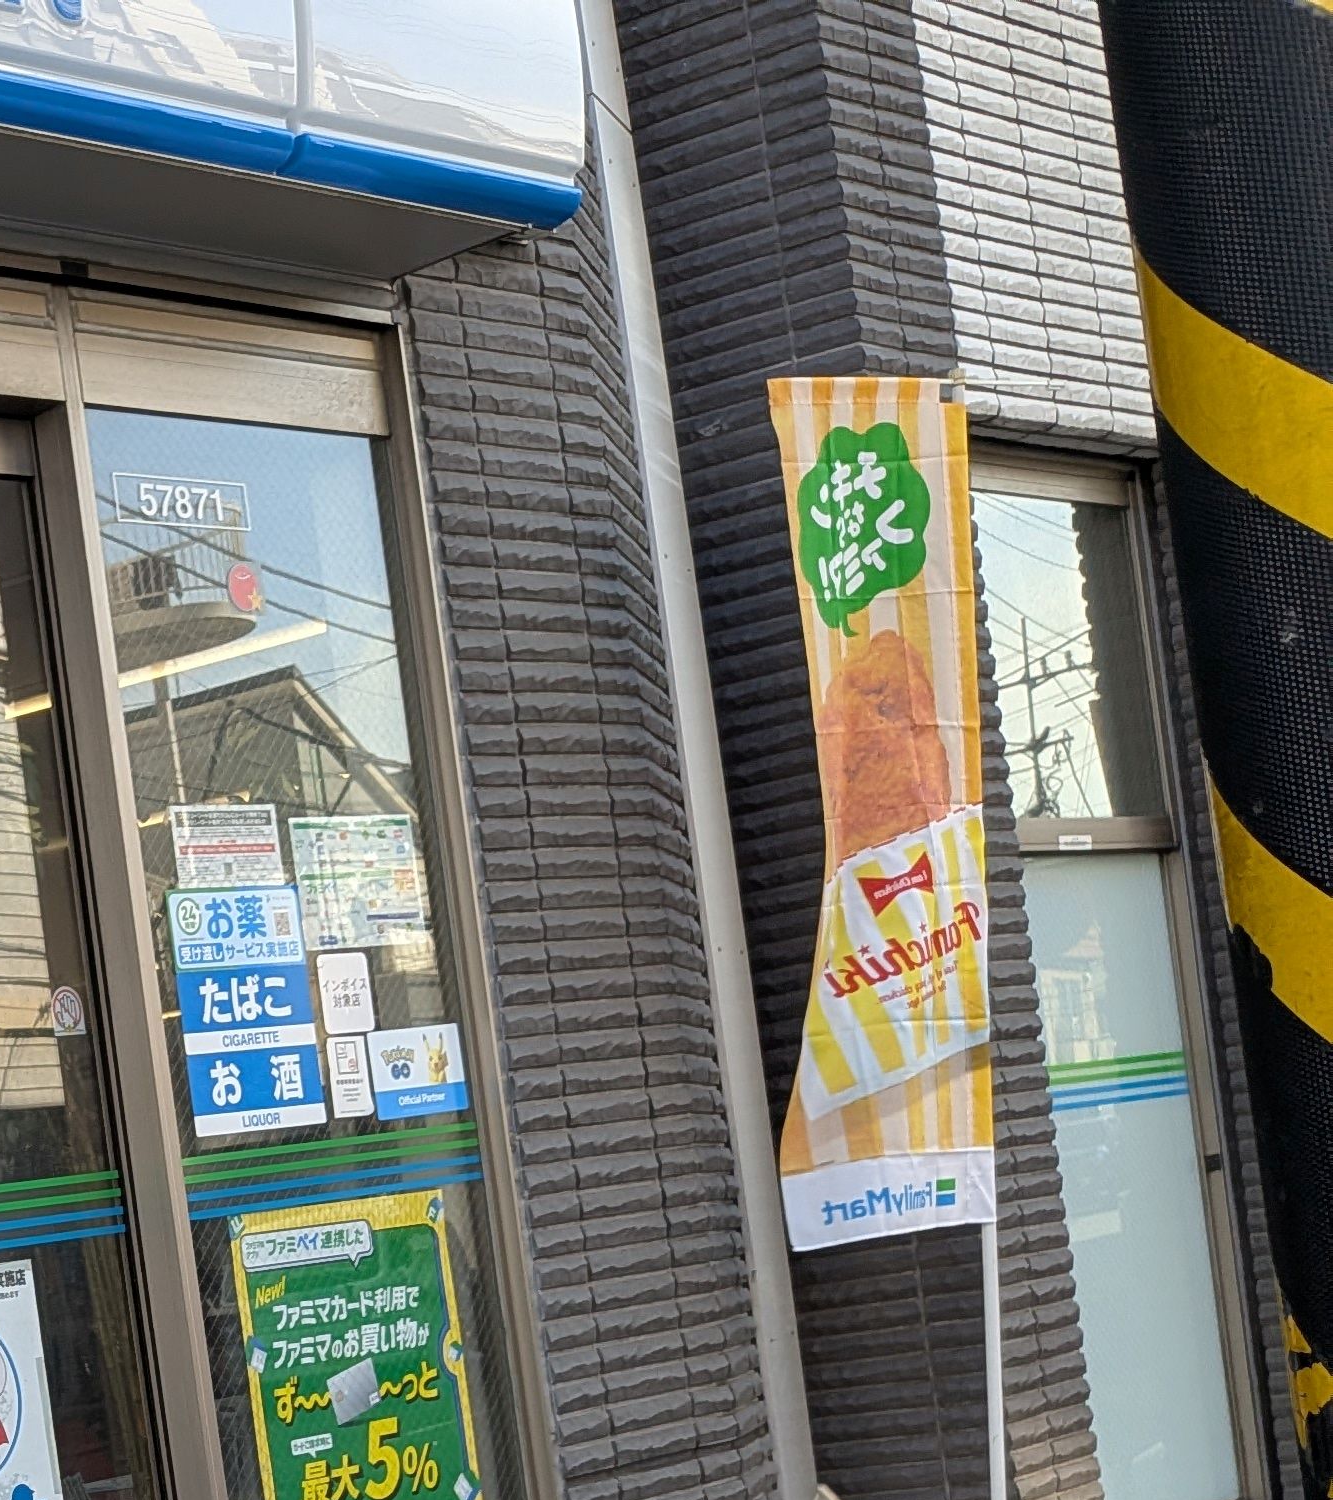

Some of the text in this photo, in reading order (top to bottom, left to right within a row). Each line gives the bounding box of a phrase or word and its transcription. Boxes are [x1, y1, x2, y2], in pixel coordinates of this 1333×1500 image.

[139, 483, 223, 521] 57871
[180, 905, 197, 922] 24
[204, 894, 267, 940] お薬
[199, 974, 293, 1025] たばこ
[322, 977, 368, 994] インボイス
[332, 992, 362, 1009] 対象店
[221, 1030, 280, 1048] CIGARETTE
[390, 1063, 411, 1080] GO
[241, 1112, 282, 1128] LIQUOR
[254, 1275, 287, 1309] New!
[272, 1285, 420, 1331] ファミマカード利用で
[272, 1320, 430, 1370] ファミマのお買い物が
